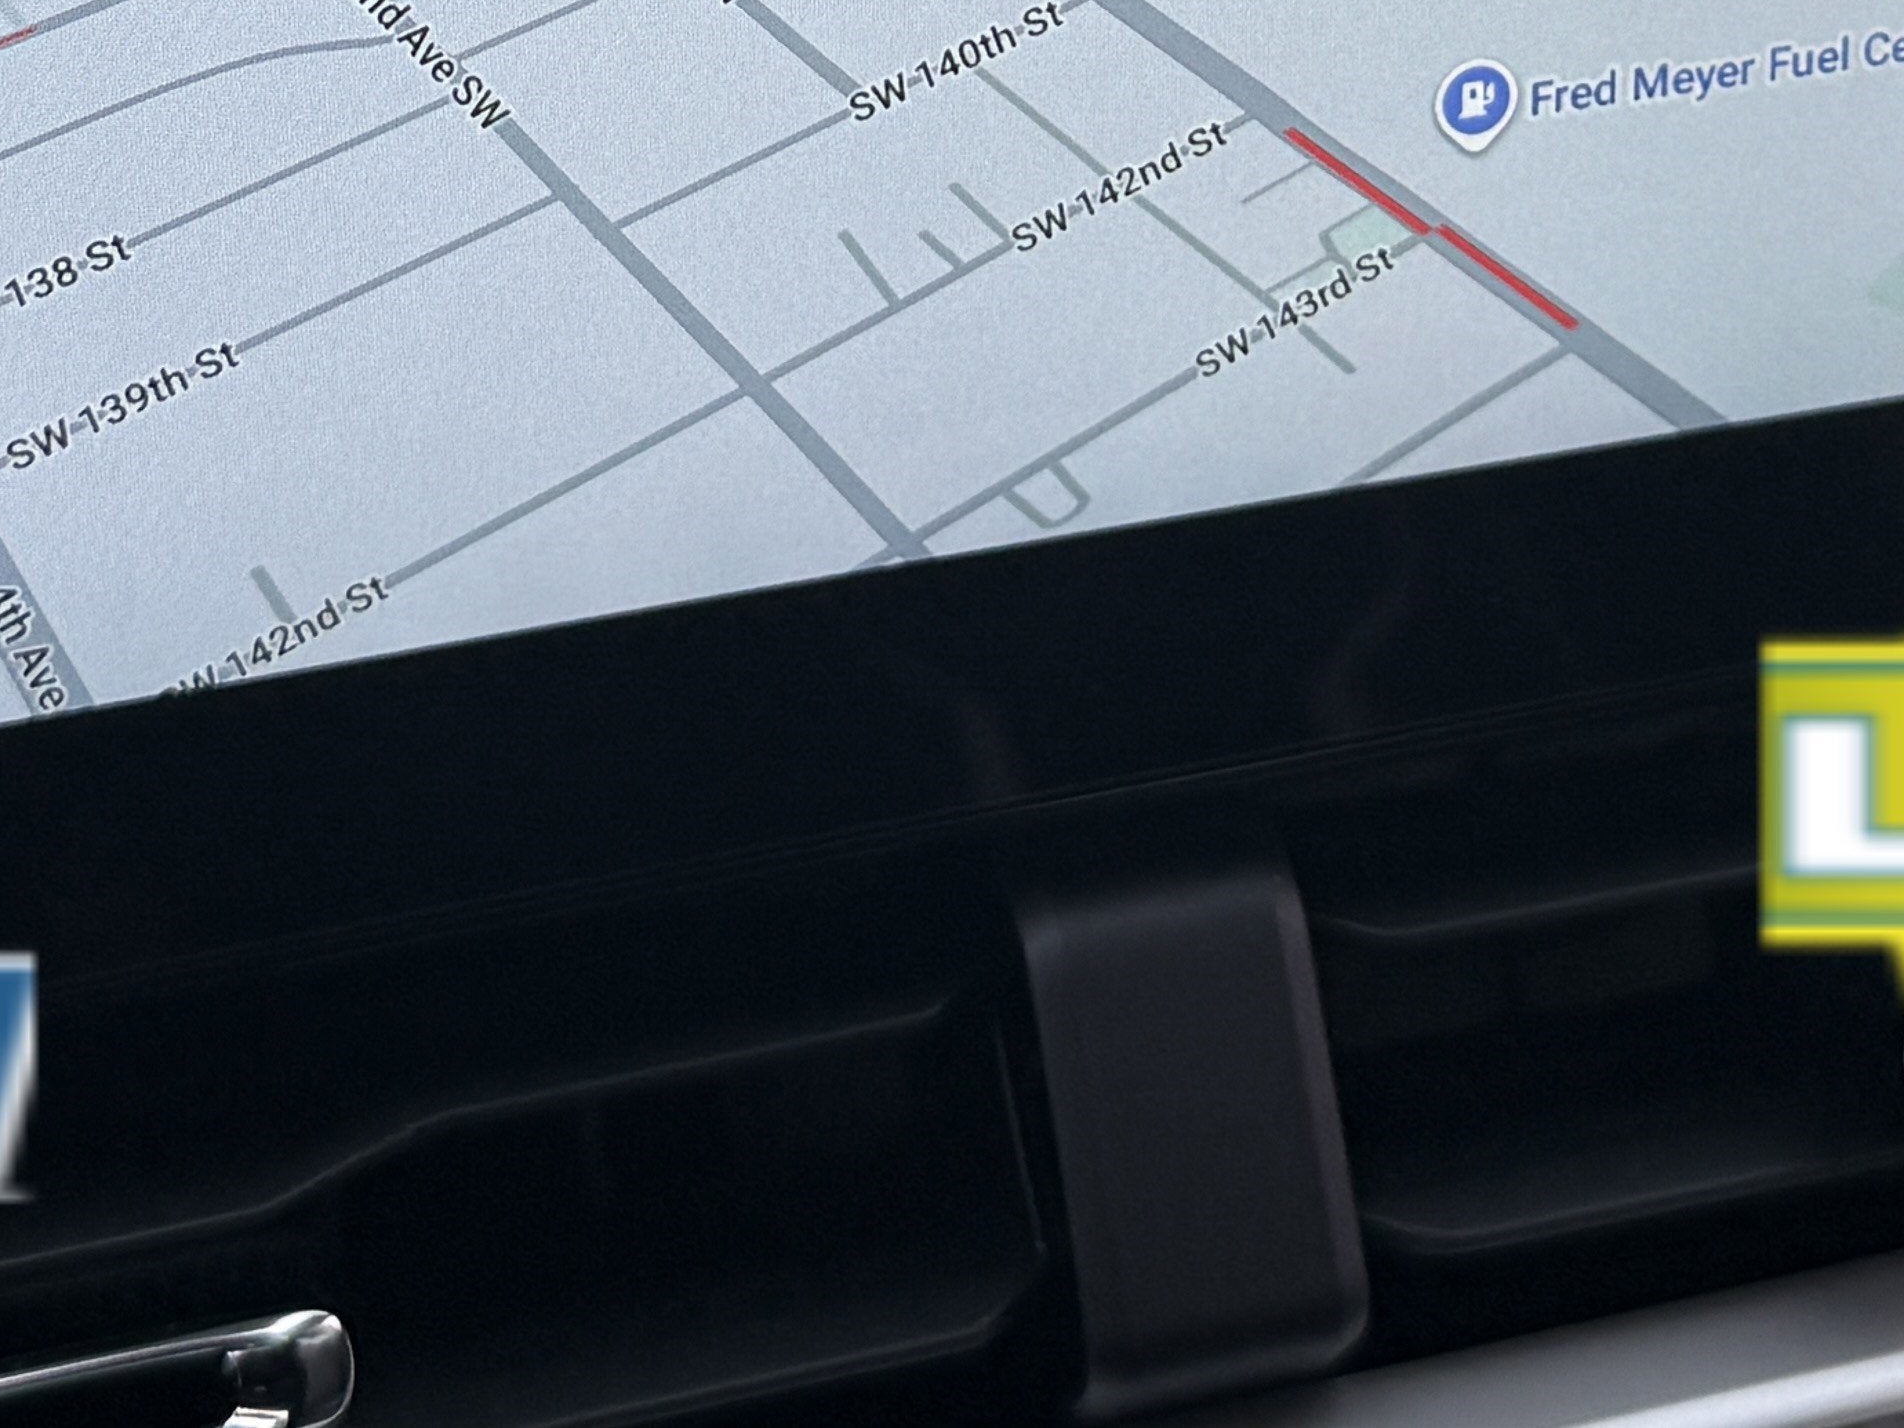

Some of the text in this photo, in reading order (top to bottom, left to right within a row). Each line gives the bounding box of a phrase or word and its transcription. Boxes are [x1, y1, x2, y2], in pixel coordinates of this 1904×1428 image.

[399, 26, 455, 84] Ave
[453, 75, 510, 129] SW
[850, 0, 1064, 121] SW 140th St
[1532, 70, 1617, 115] Fred
[1634, 60, 1755, 101] Meyer
[1771, 37, 1849, 81] Fuel
[1012, 122, 1228, 252] SW 142nd St
[3, 256, 78, 308] 138
[85, 234, 130, 271] St
[1195, 249, 1394, 378] SW 143rd St
[7, 343, 238, 470] SW 139th St
